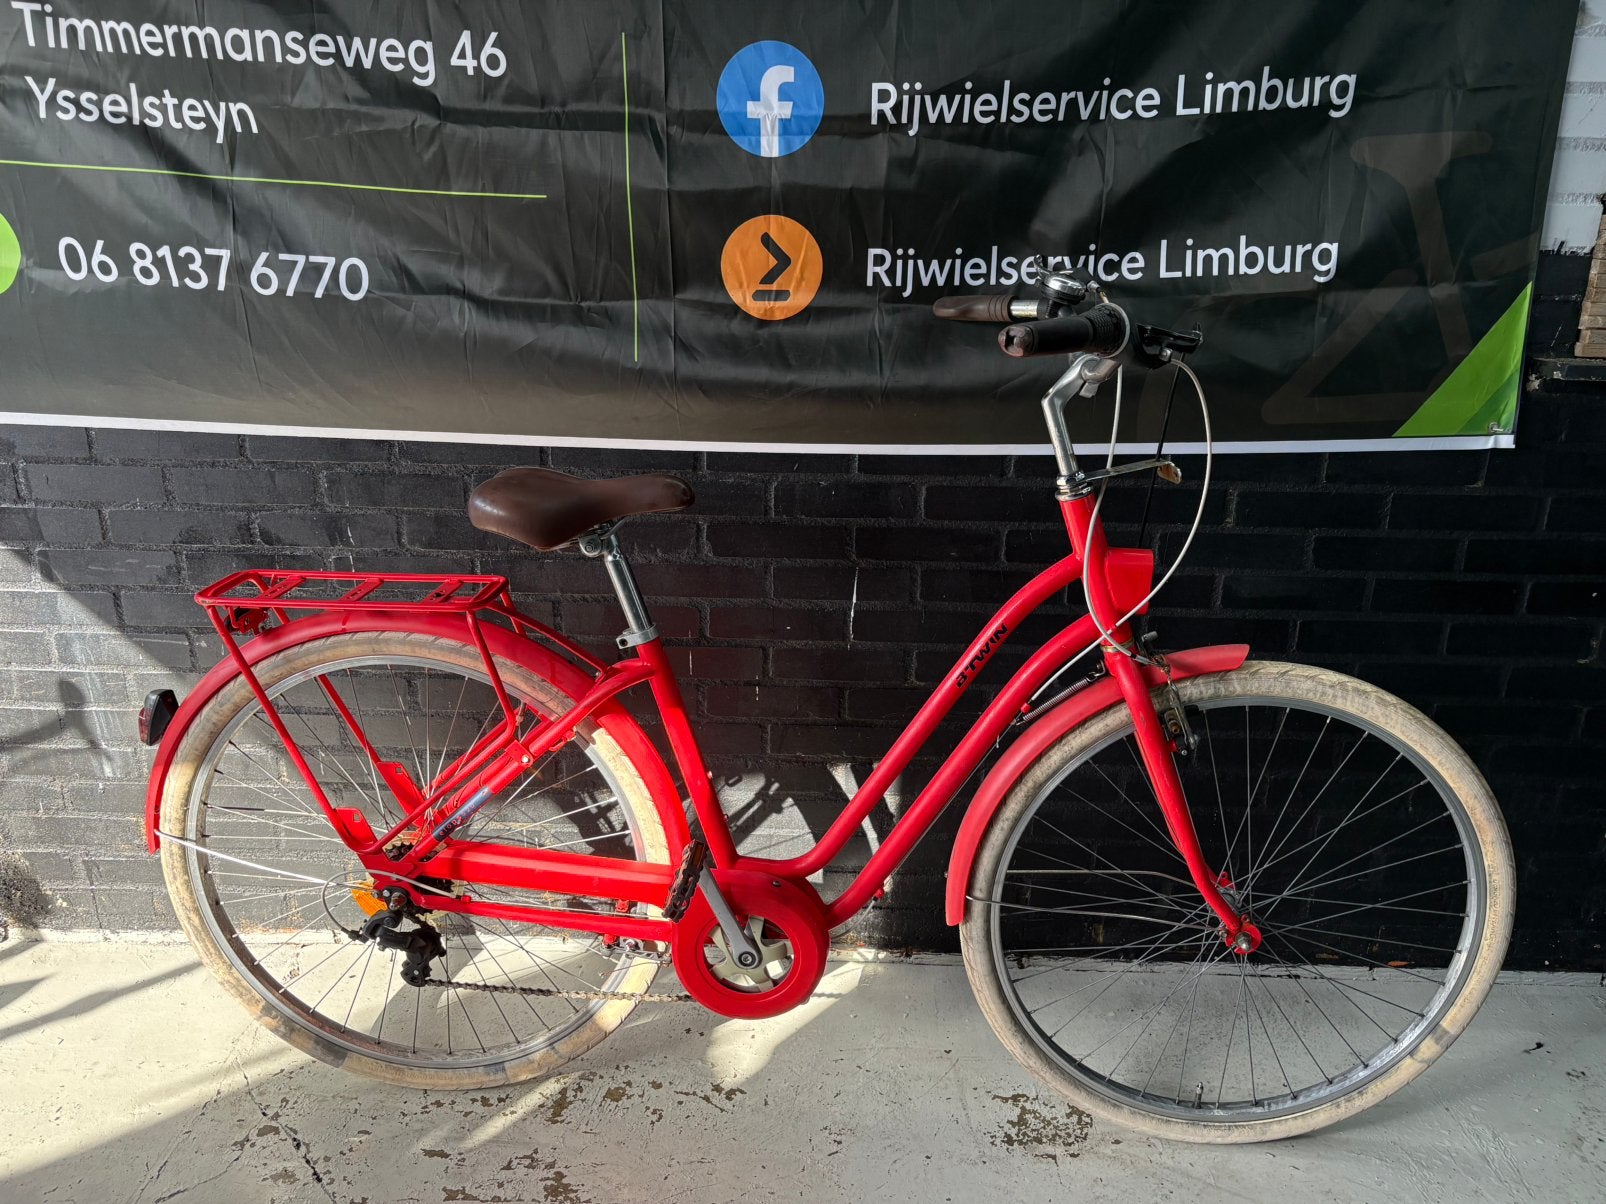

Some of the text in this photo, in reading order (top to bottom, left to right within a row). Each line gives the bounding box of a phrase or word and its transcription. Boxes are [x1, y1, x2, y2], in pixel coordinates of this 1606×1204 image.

[10, 1, 508, 87] Timmermanseweg 46
[24, 75, 259, 144] Ysselsteyn
[870, 65, 1357, 137] Rijwielservice Limburg
[58, 236, 369, 301] 06 8137 6770
[1159, 234, 1339, 284] Limburg
